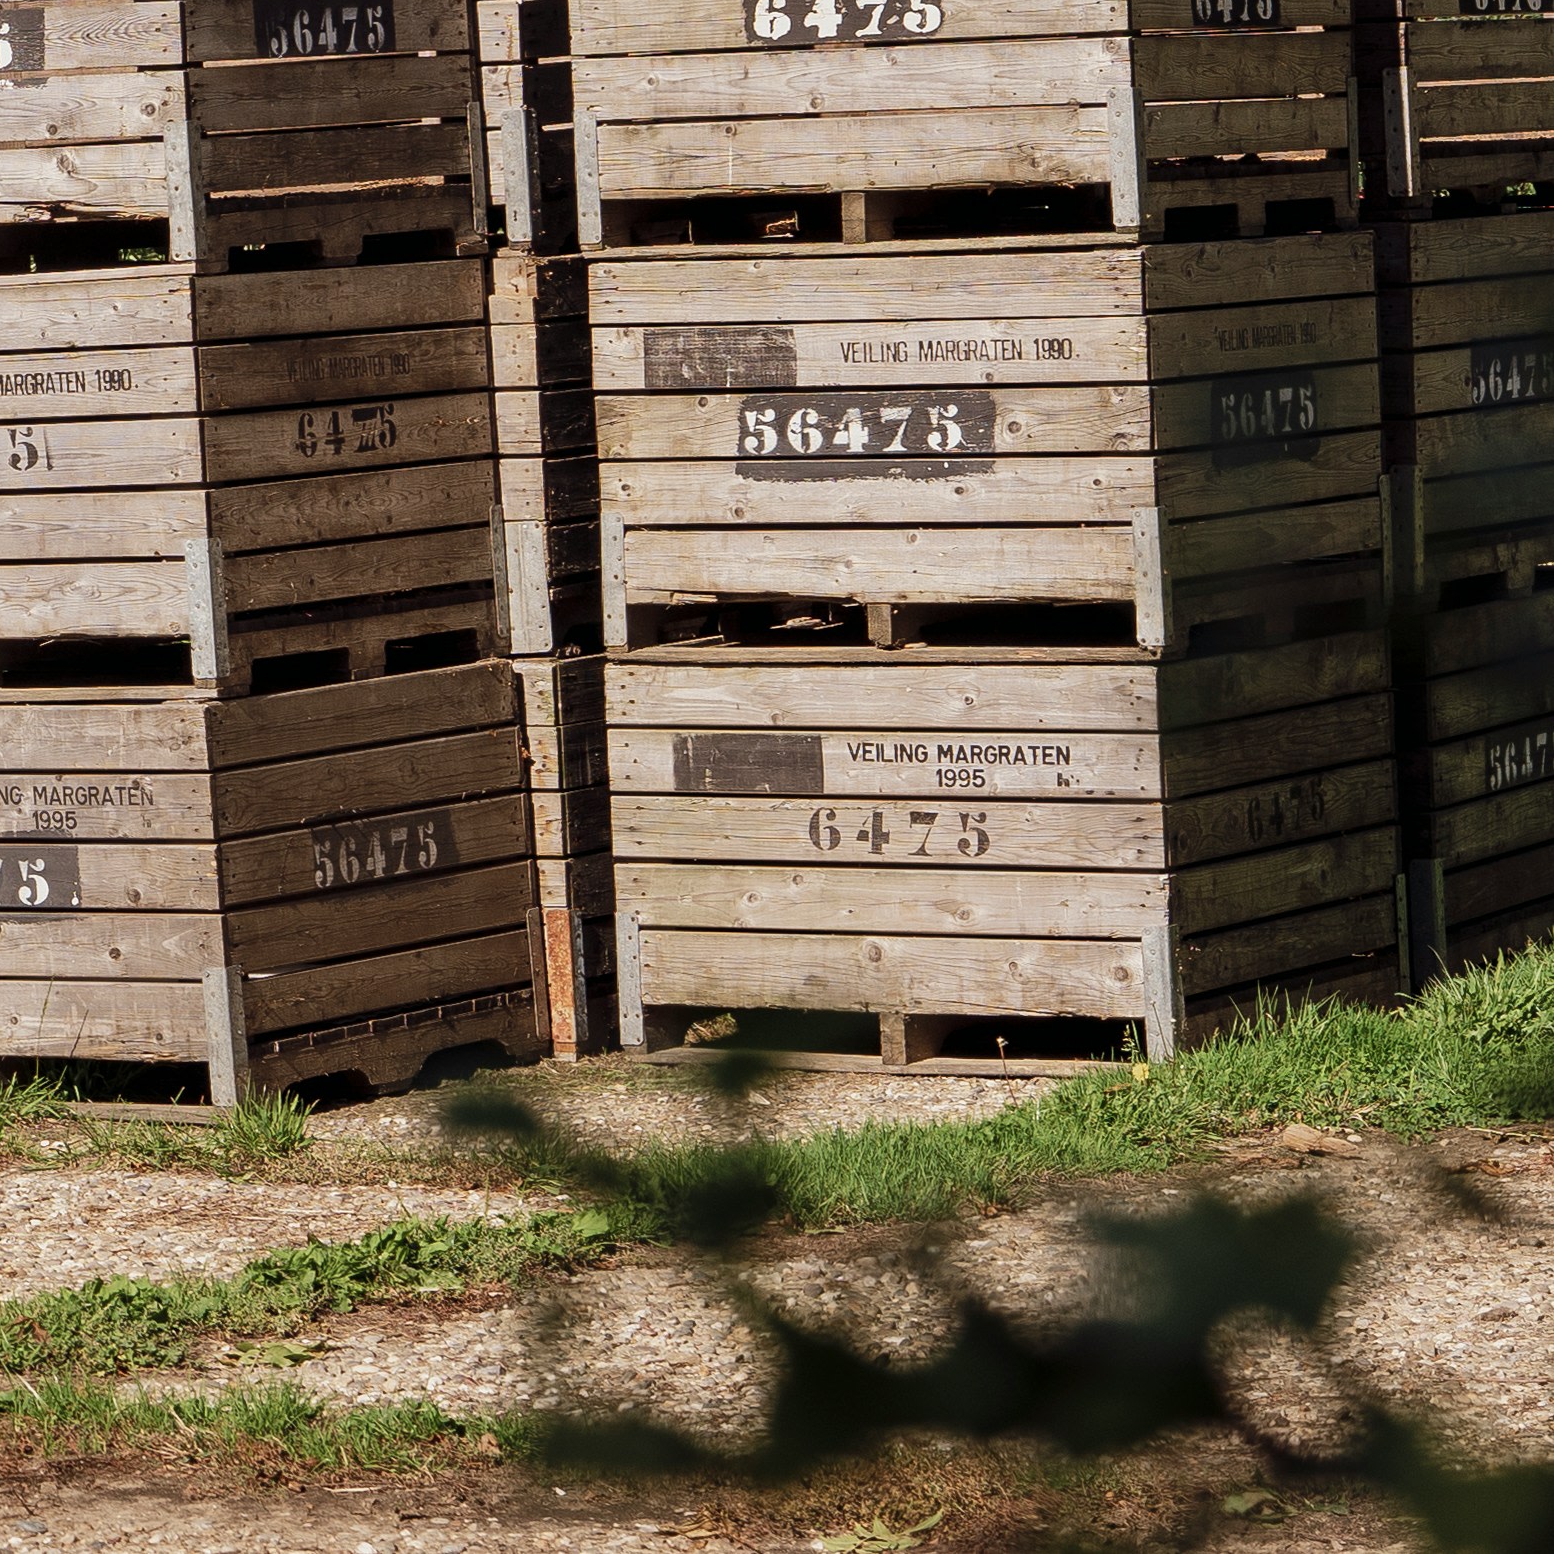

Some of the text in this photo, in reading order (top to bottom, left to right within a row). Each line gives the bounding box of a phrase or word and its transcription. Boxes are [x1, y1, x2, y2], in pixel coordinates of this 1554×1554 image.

[269, 5, 385, 59] 56475
[840, 339, 908, 365] VEILING
[918, 338, 1023, 363] MARGRATEN
[297, 403, 397, 458] 6475
[744, 403, 962, 455] 56475
[1220, 384, 1314, 439] 56475
[847, 743, 1072, 765] VEILING MARGRATEN
[935, 769, 987, 789] 1995
[1489, 730, 1554, 791] 5647
[32, 785, 154, 806] MARGRATEN
[32, 810, 77, 830] 1995
[313, 821, 438, 889] 56475
[809, 807, 992, 860] 6475
